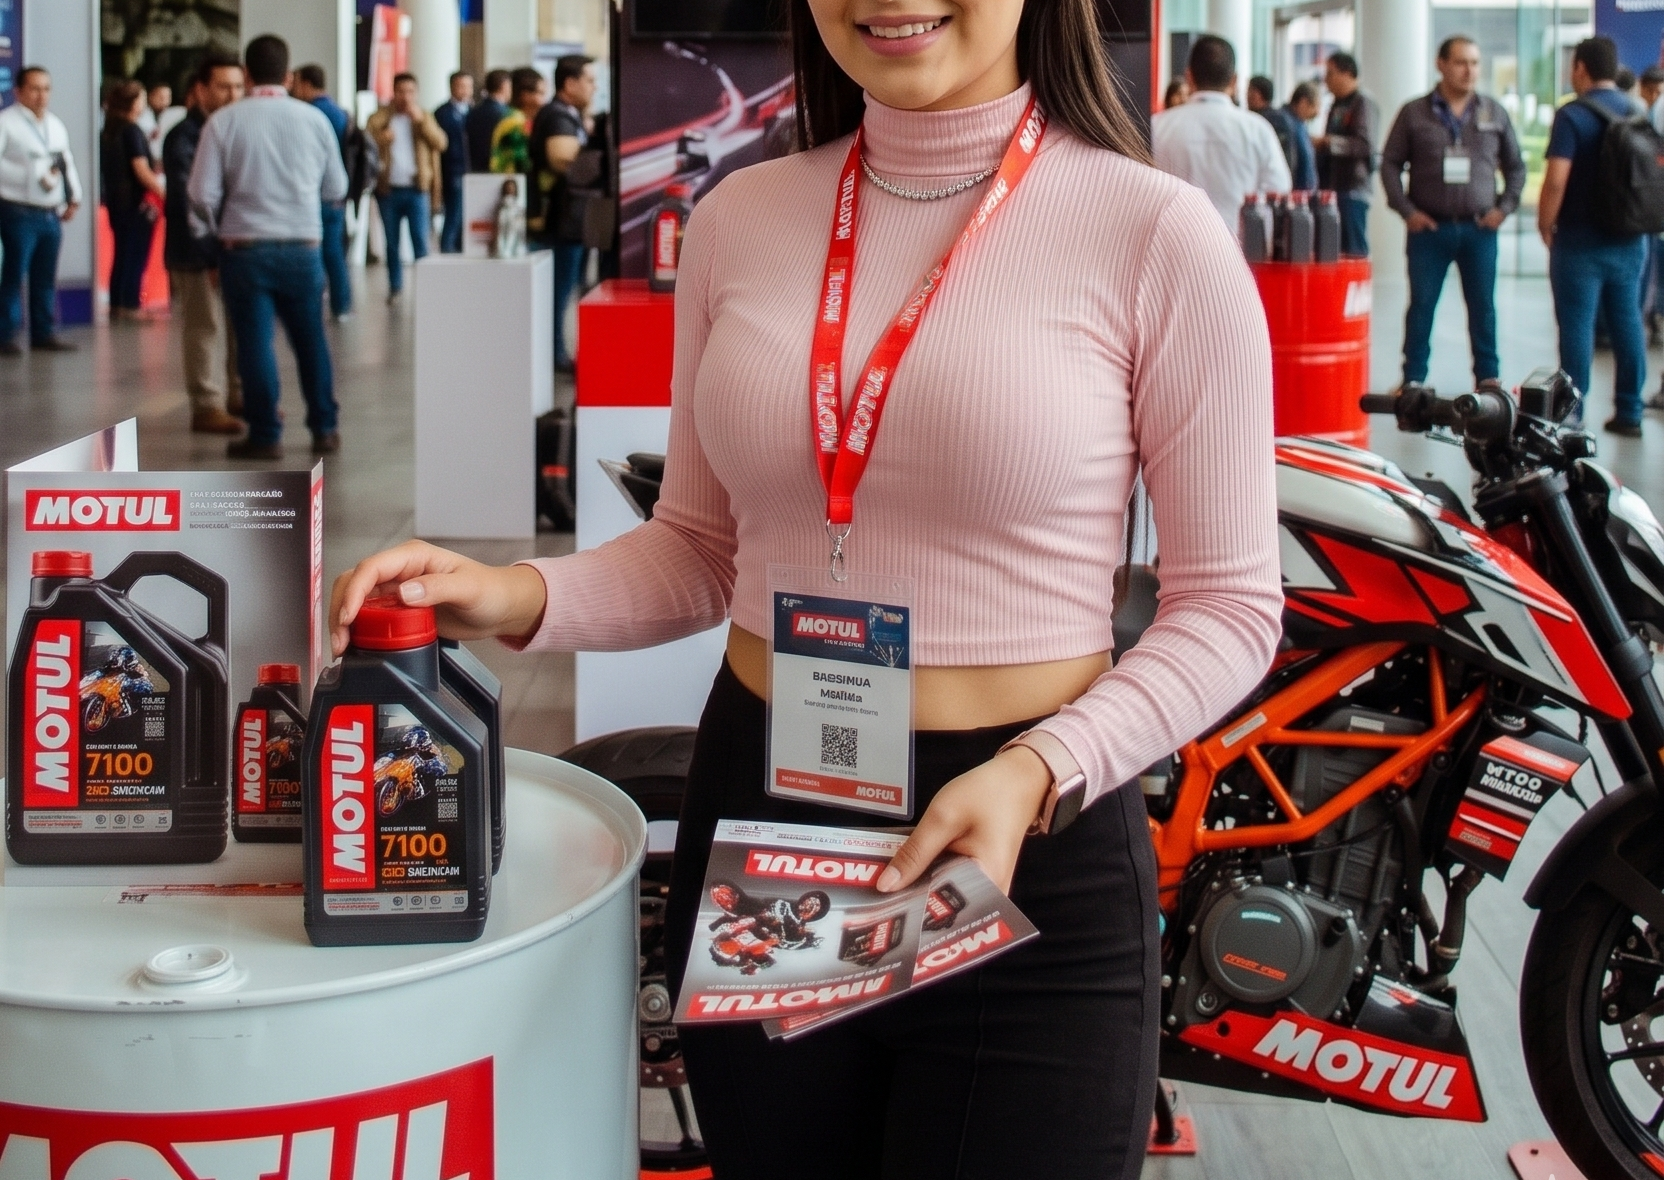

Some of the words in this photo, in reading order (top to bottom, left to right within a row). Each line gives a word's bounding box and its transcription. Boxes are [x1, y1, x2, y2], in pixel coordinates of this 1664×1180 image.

[32, 496, 173, 525] MOTUL
[796, 616, 860, 639] MOTUL
[35, 634, 72, 793] MOTUL
[86, 752, 153, 776] 7100
[243, 718, 262, 805] MOTUL
[331, 720, 366, 874] MOTUL
[381, 833, 447, 858] 7100
[751, 853, 879, 885] MOTUL
[1252, 1018, 1458, 1110] MOTUL
